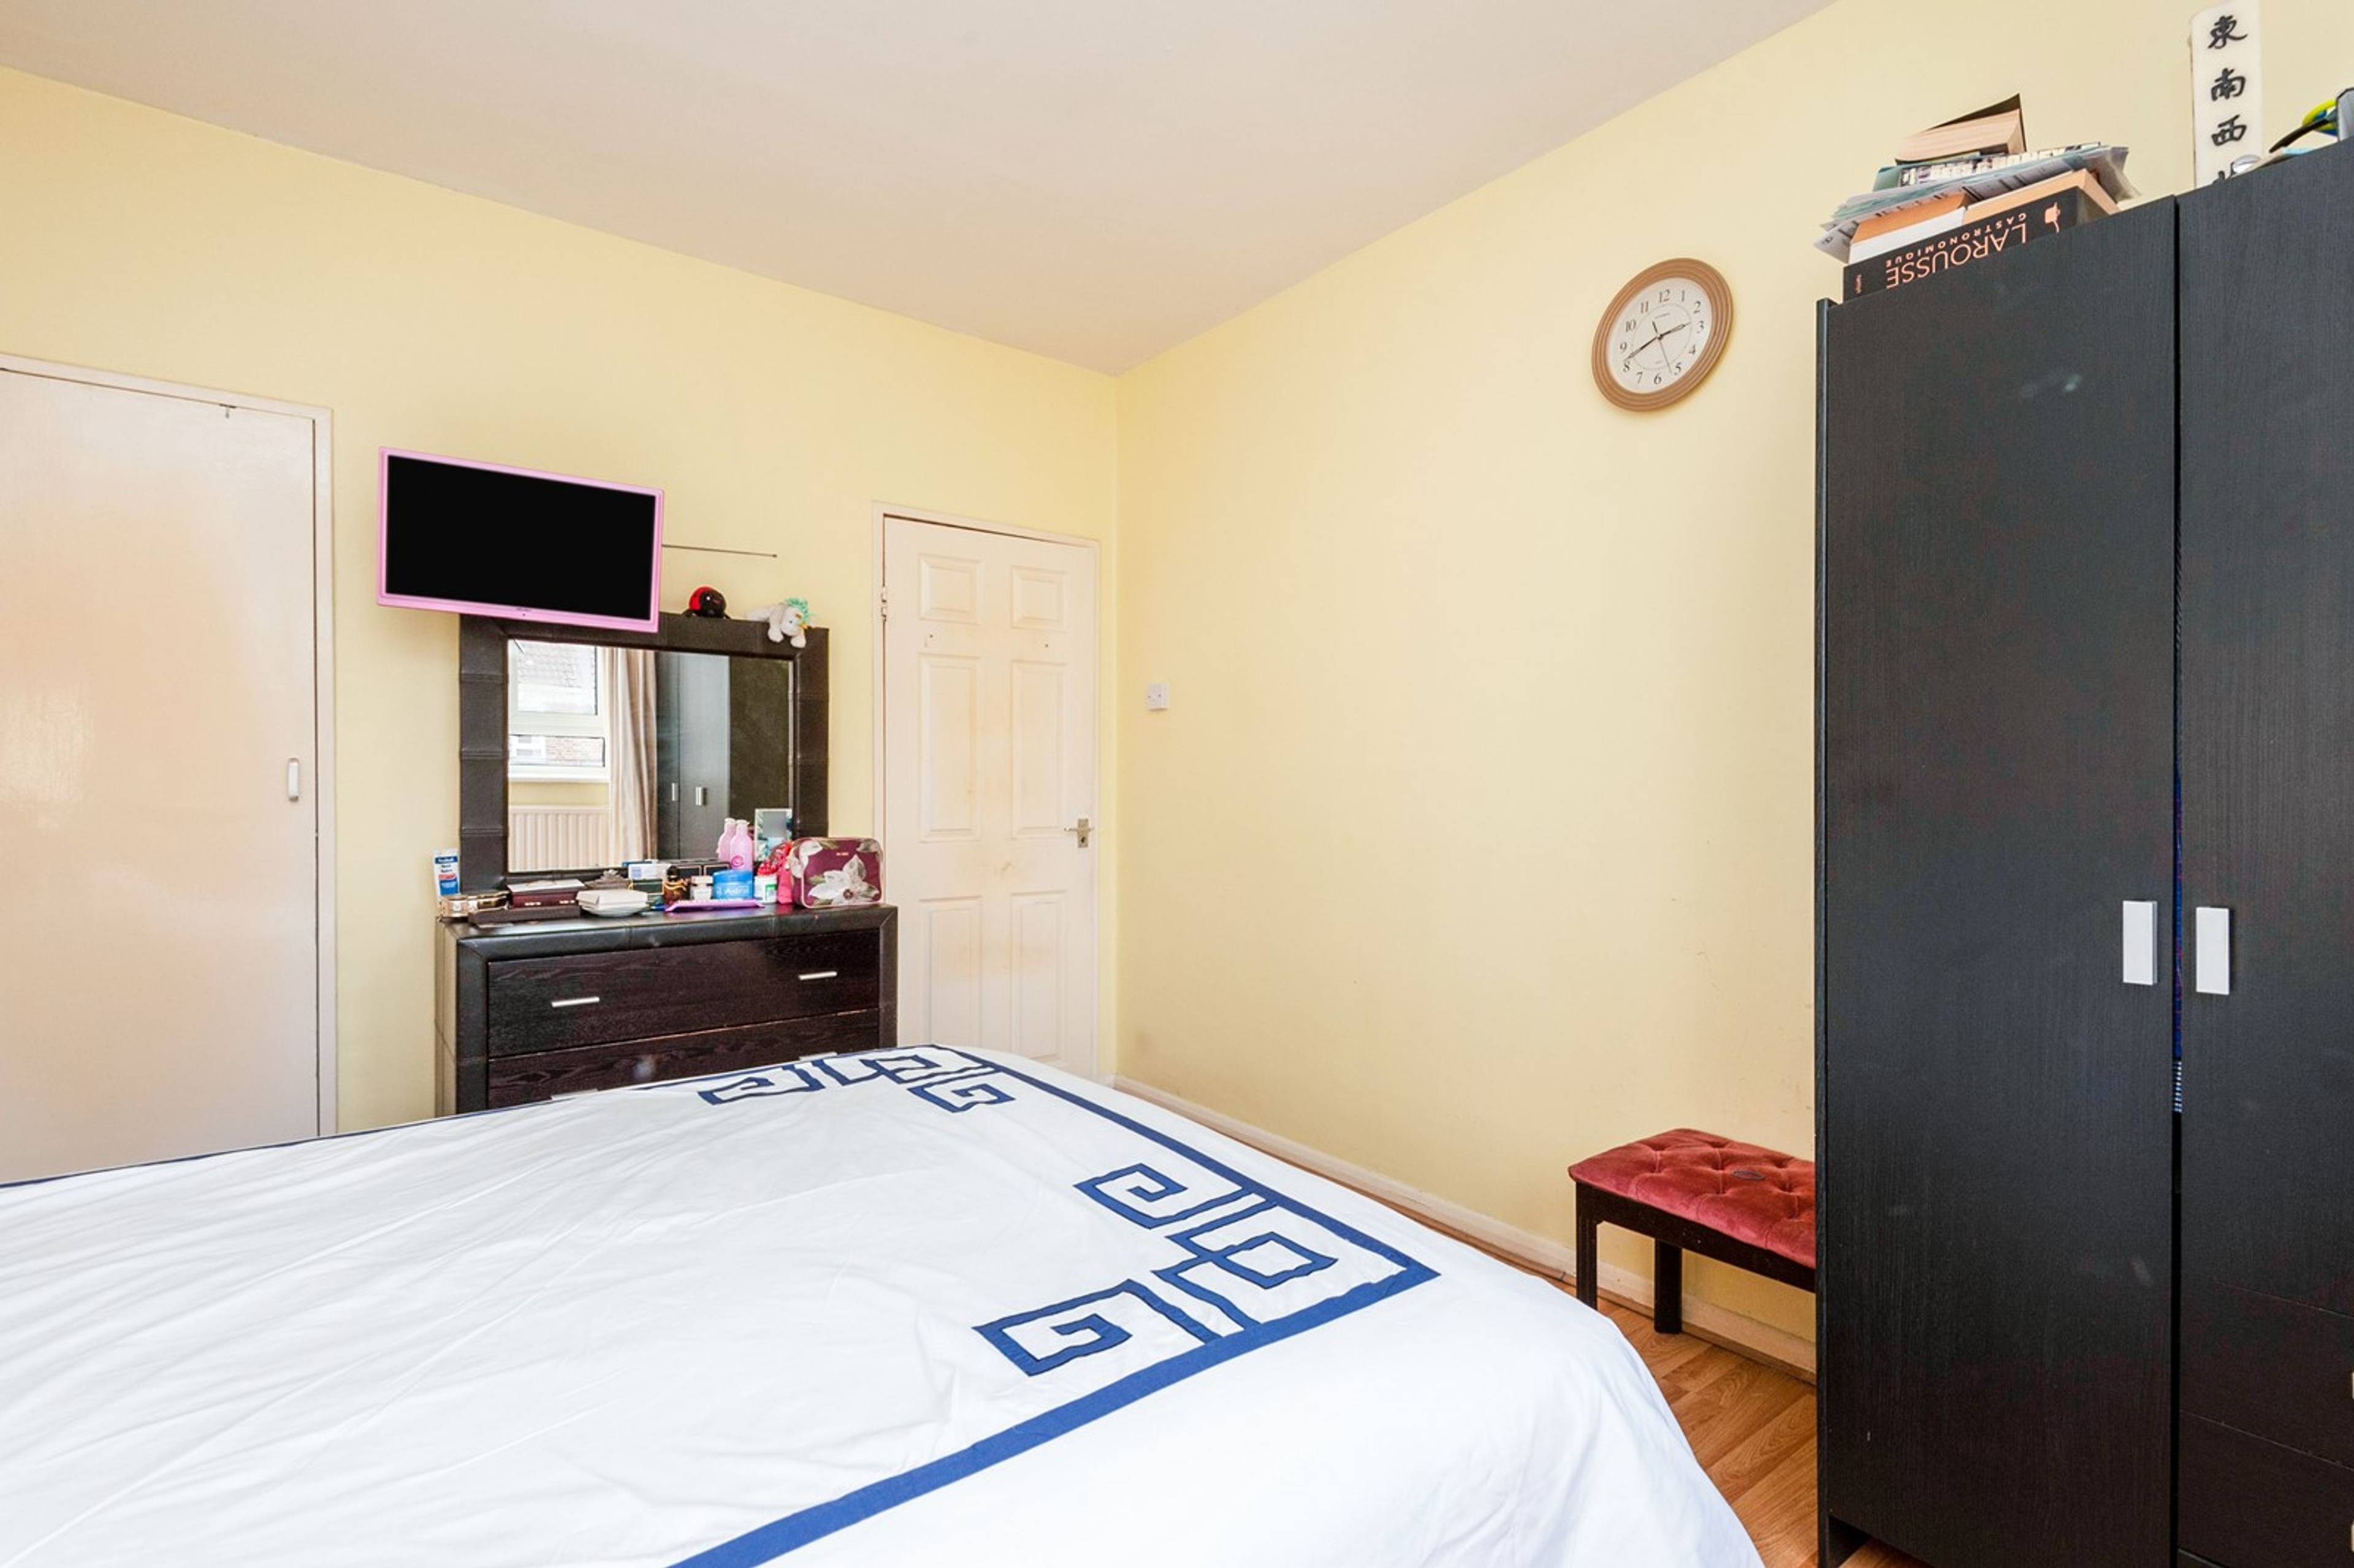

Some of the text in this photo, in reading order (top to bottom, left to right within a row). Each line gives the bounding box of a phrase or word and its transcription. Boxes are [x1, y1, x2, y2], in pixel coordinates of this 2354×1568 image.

[1886, 213, 2027, 267] GASTRONOMIQUE
[1886, 223, 2026, 289] LAROUSSE
[1659, 289, 1670, 303] 12
[1681, 290, 1685, 302] 1
[1640, 301, 1648, 314] 11
[1693, 300, 1701, 314] 2
[1626, 319, 1637, 332] 10
[1697, 321, 1704, 333] 3
[1620, 341, 1628, 353] 9
[1689, 344, 1696, 355] 4
[1623, 360, 1630, 373] 8
[1674, 362, 1682, 375] 5
[1636, 371, 1643, 384] 7
[1653, 373, 1661, 385] 6
